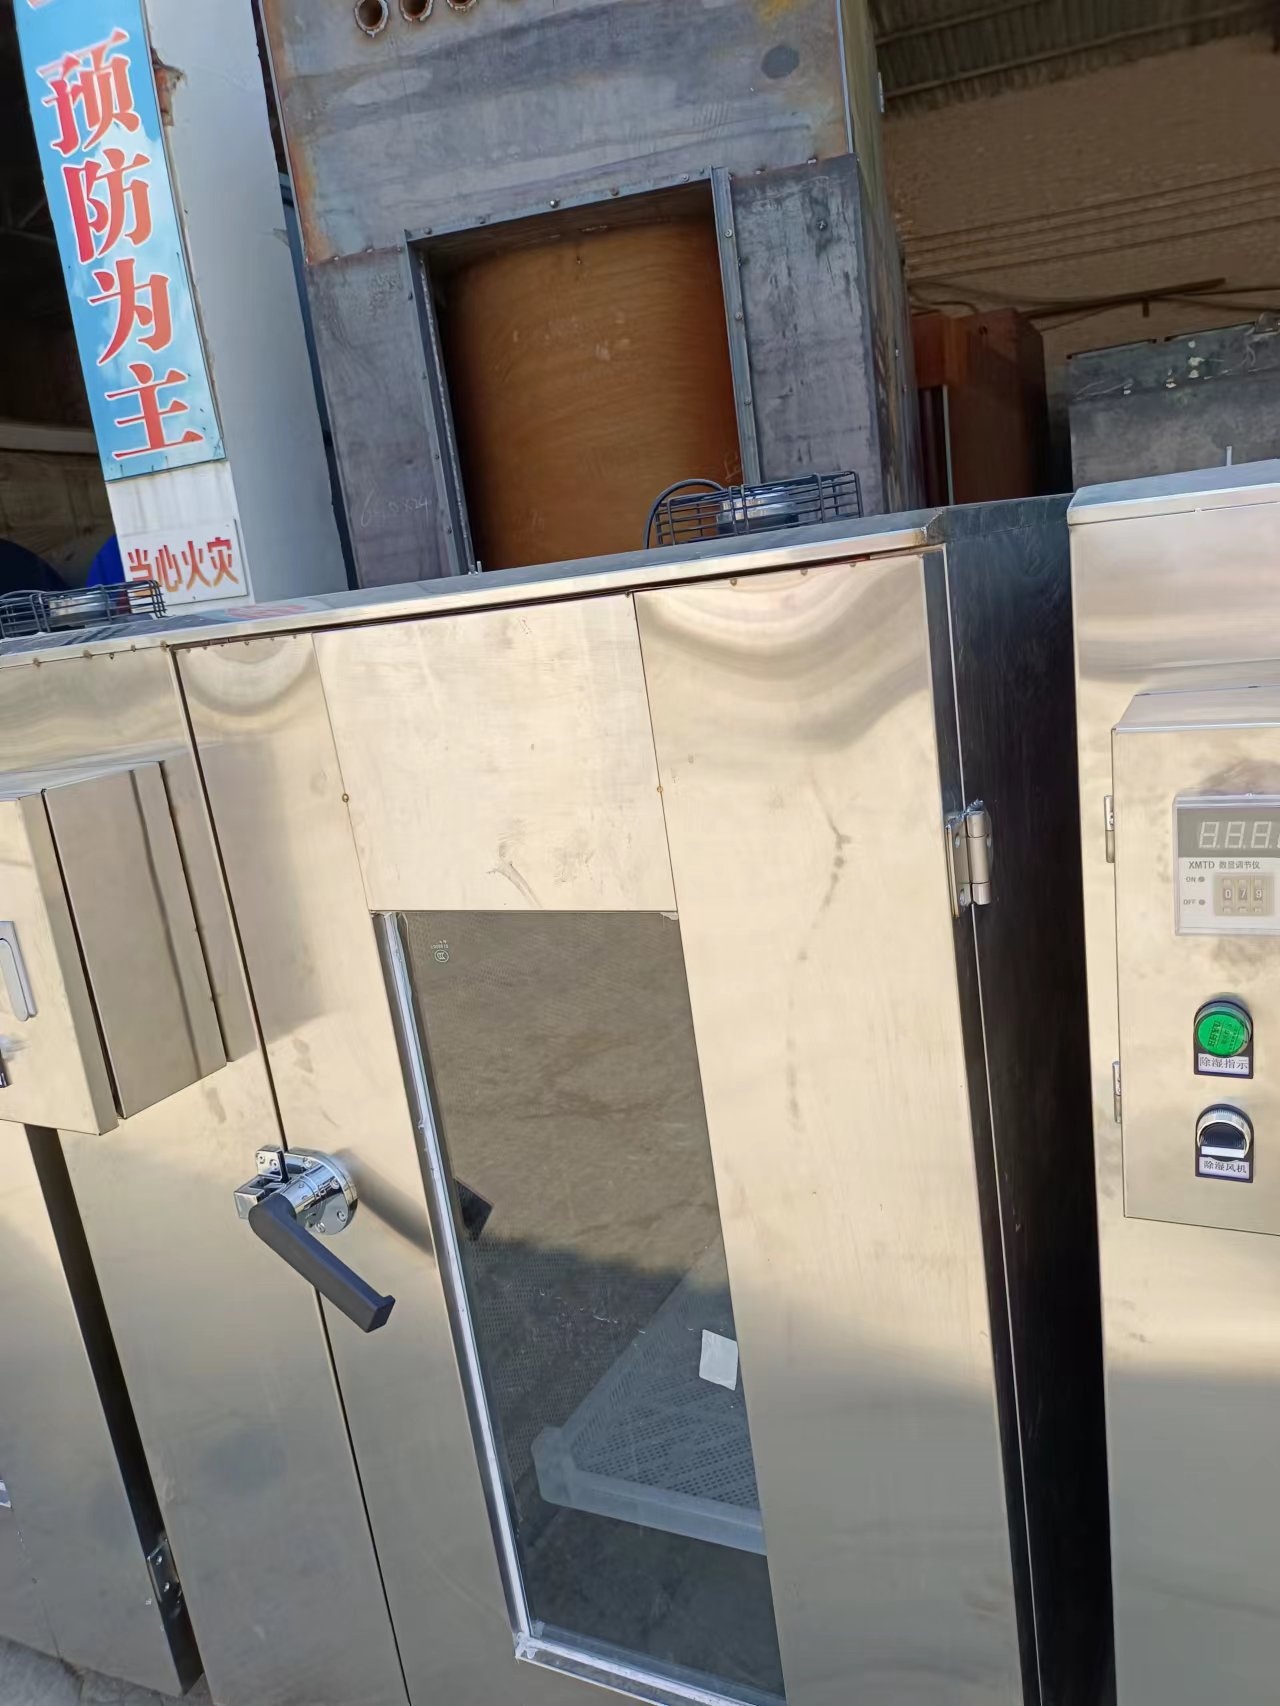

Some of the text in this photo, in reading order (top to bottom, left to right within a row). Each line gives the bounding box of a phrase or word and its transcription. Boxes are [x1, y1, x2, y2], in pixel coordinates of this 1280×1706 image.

[38, 28, 204, 460] 预防为主
[127, 536, 240, 592] 当心火灾
[1188, 860, 1261, 869] XMTD 数显调节仪
[1199, 1056, 1248, 1070] 除湿指示
[1203, 1160, 1247, 1174] 除湿风机
